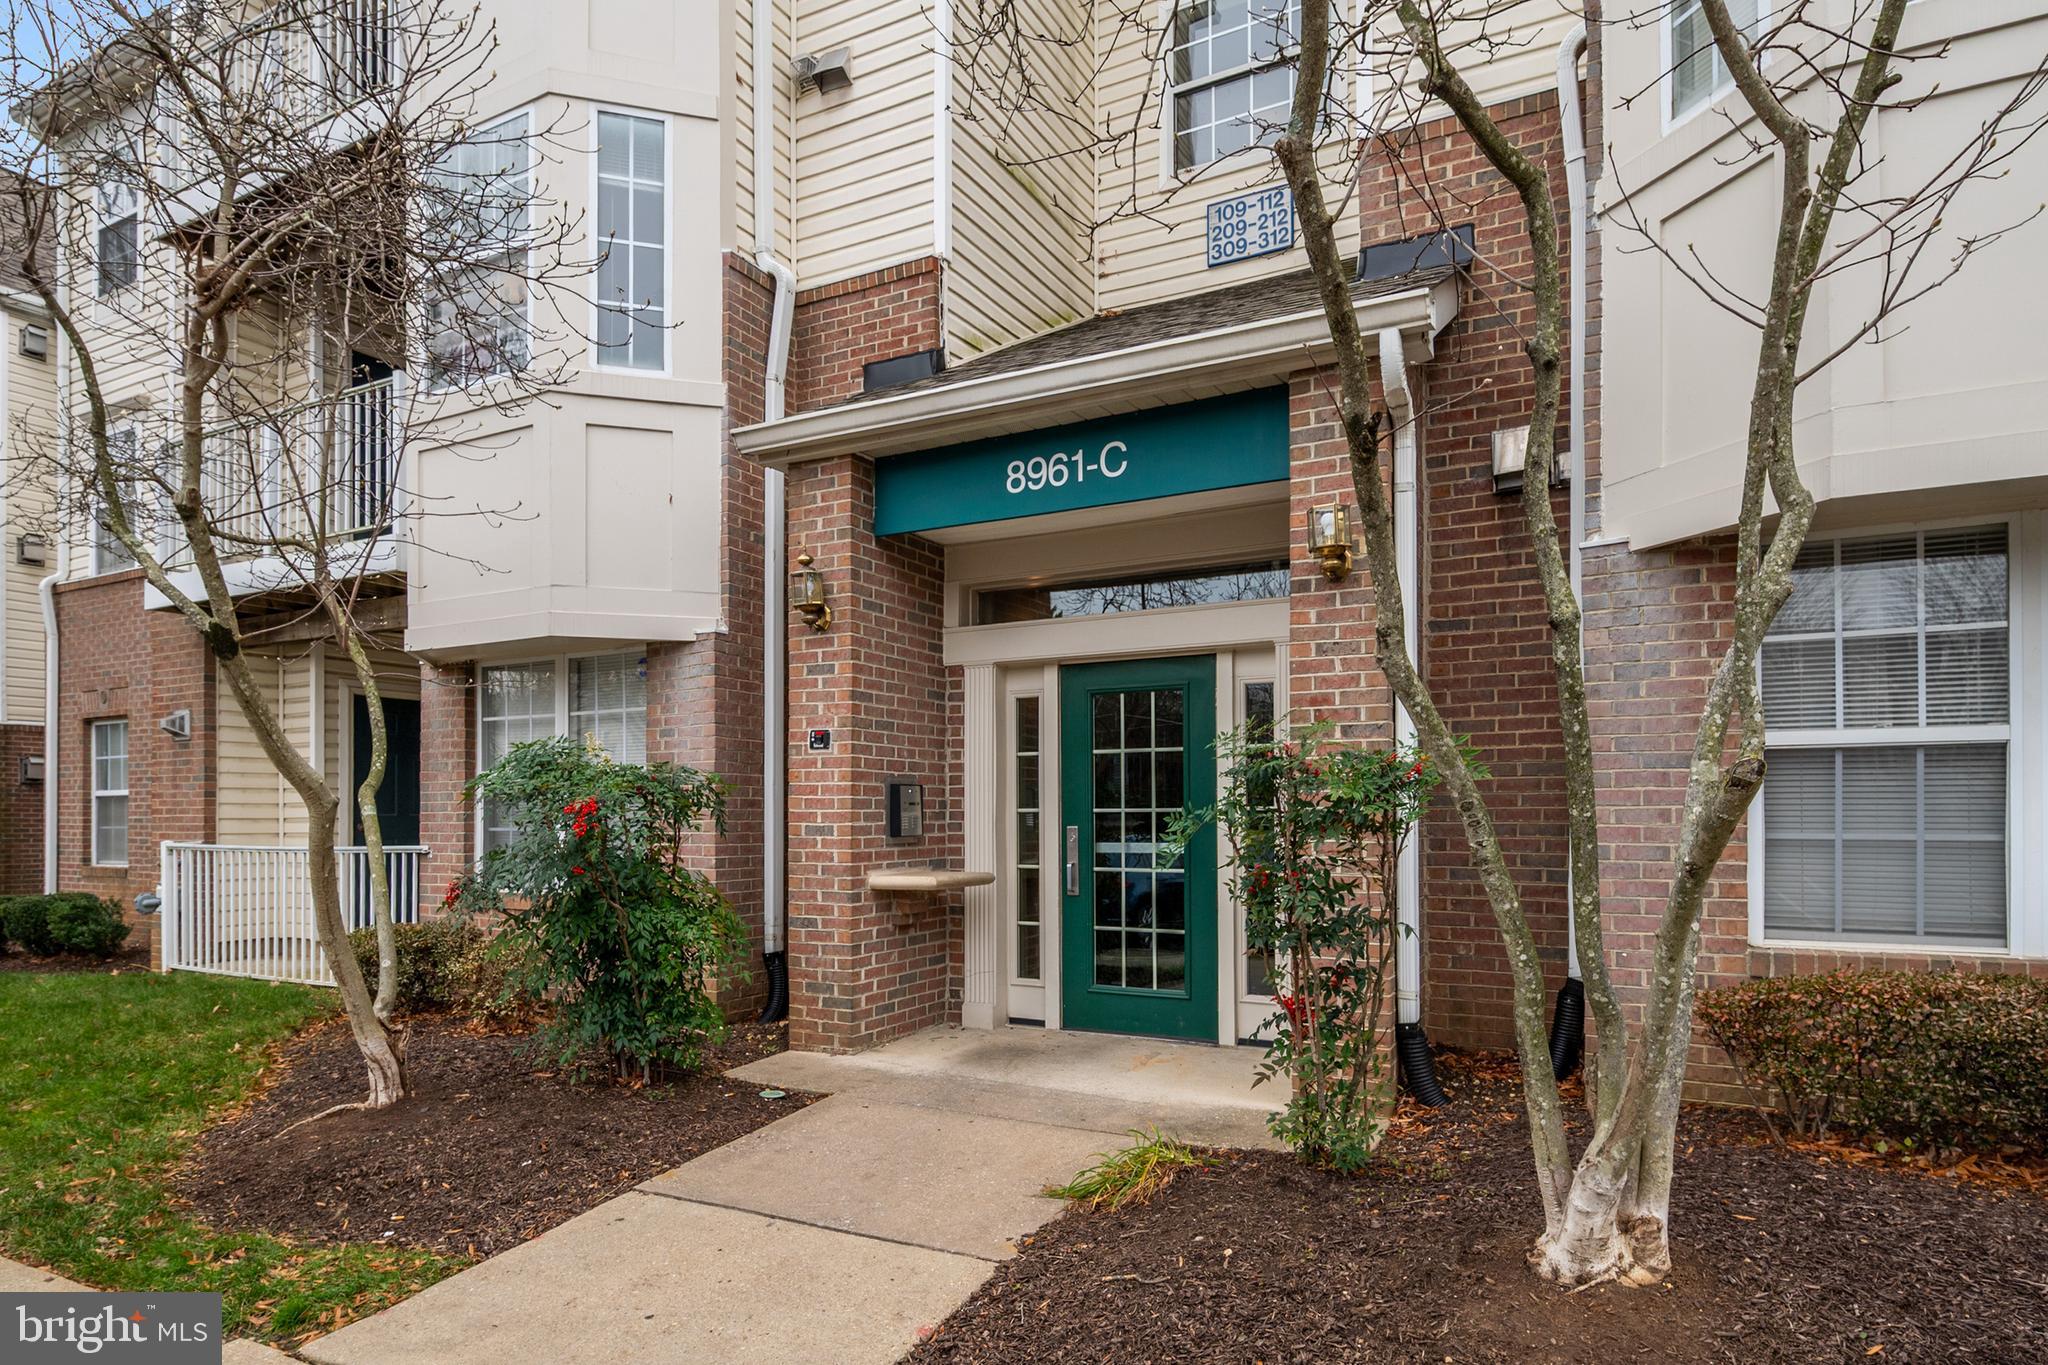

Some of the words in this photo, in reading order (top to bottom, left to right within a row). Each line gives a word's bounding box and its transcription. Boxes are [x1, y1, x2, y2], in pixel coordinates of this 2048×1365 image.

[1214, 190, 1285, 223] 109-112
[1212, 208, 1288, 243] 209-212
[1211, 227, 1290, 260] 309-312
[1006, 440, 1128, 494] 8961-C
